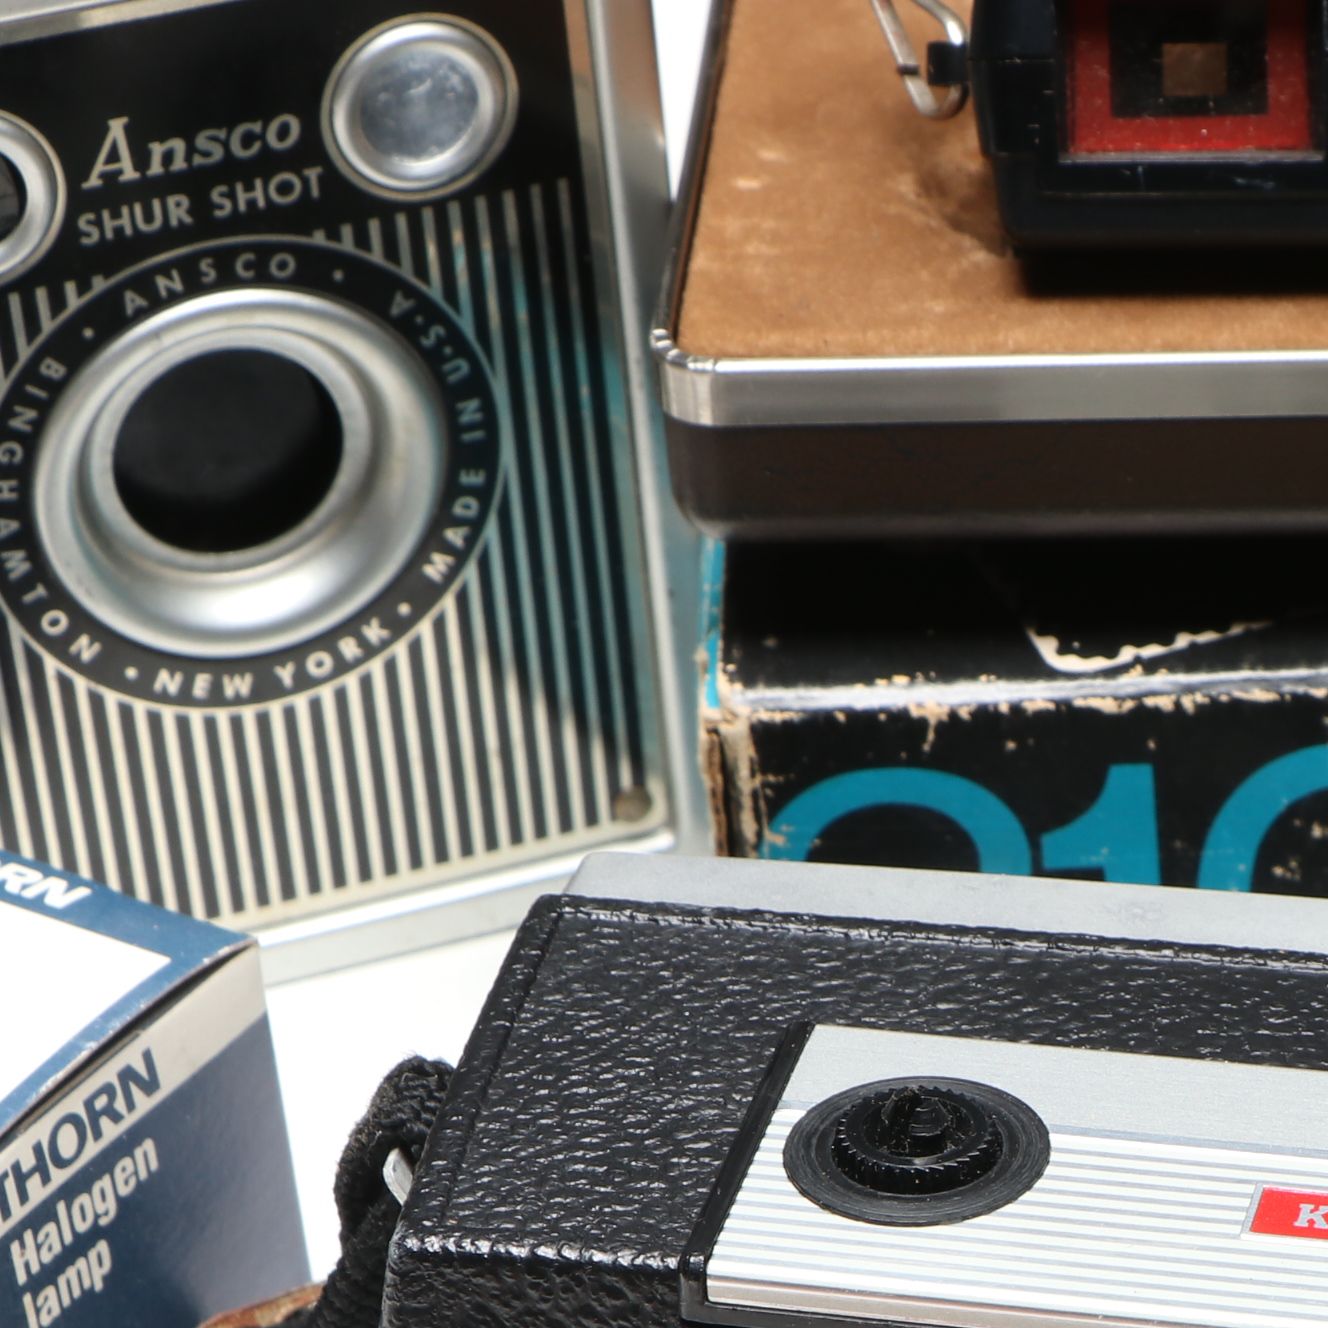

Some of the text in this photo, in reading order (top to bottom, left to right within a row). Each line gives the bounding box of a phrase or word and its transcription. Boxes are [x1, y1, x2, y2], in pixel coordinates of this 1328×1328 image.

[77, 166, 324, 246] SHUR SHOT
[81, 113, 302, 190] Ansco
[123, 252, 297, 318] ANSCO
[153, 668, 254, 701] NEW
[273, 616, 392, 690] YORK
[421, 468, 486, 583] MADE
[455, 396, 487, 444] IN
[0, 1047, 160, 1223] THORN
[9, 1136, 160, 1287] Halogen
